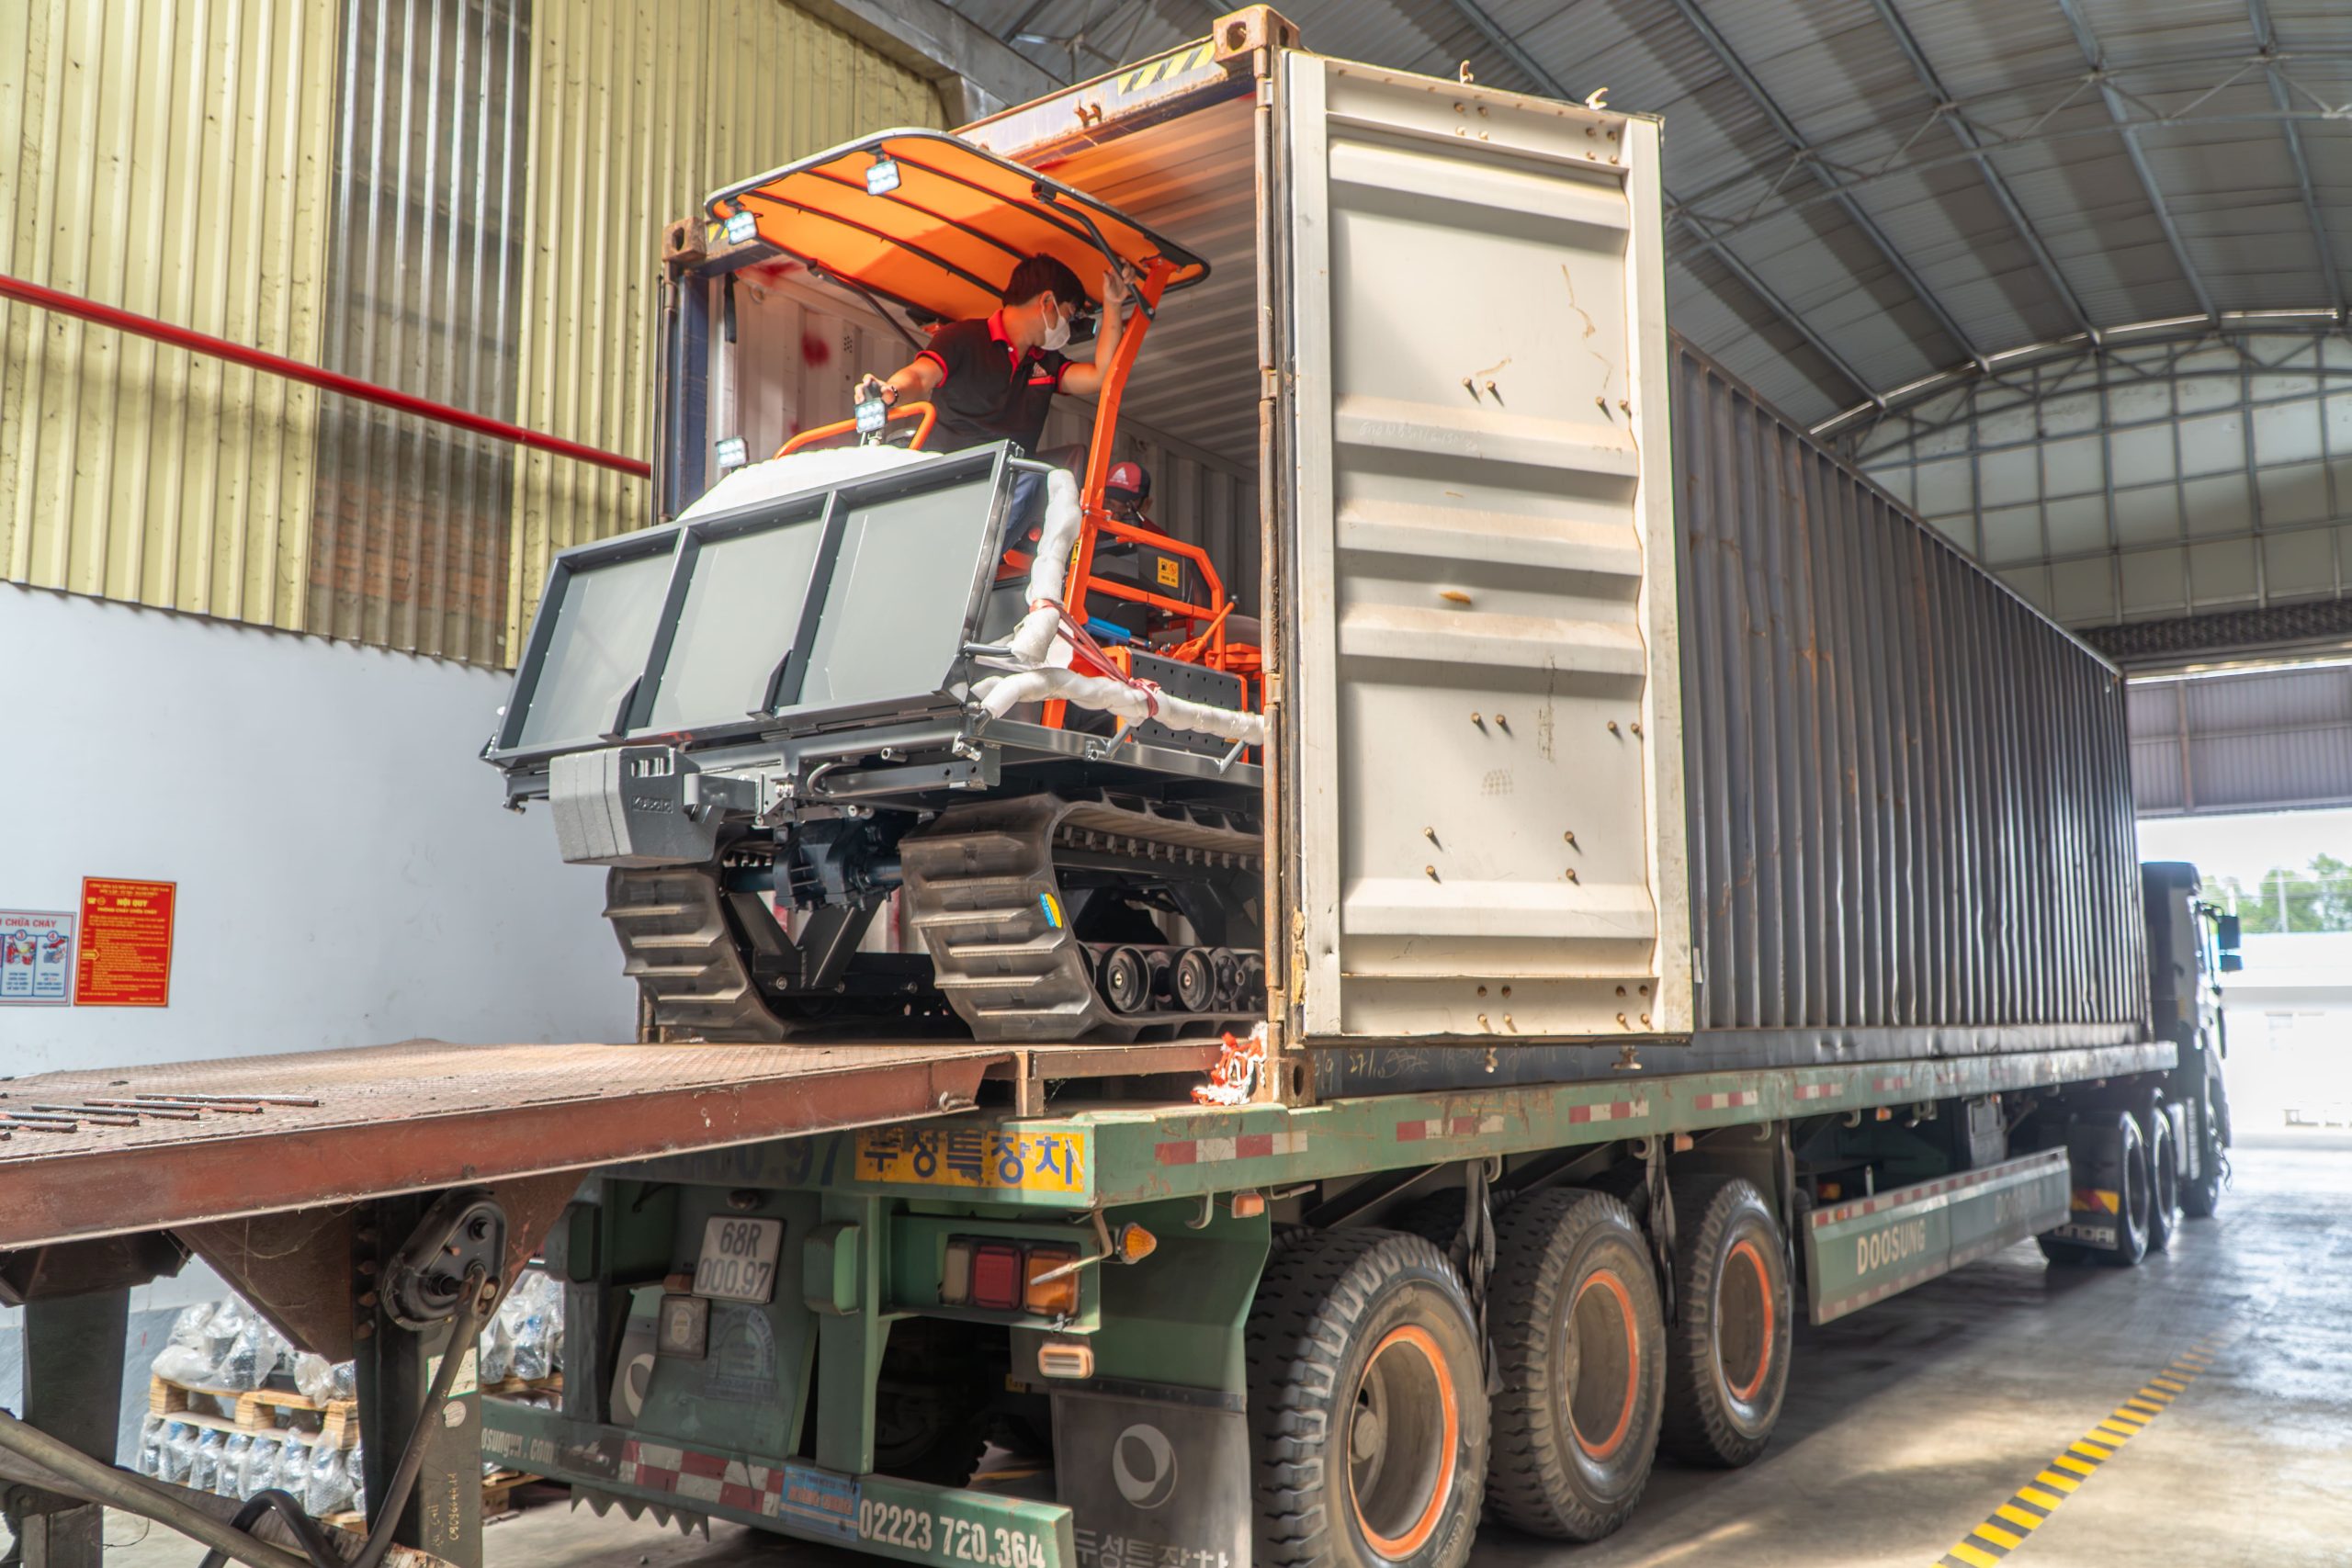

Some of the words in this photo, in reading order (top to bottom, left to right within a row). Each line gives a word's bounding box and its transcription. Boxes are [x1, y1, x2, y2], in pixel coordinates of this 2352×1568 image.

[719, 1222, 762, 1258] 68R
[1857, 1219, 1926, 1276] DOOSUNG
[696, 1258, 772, 1297] 000.97
[858, 1499, 933, 1551] 02223
[939, 1516, 1046, 1568] 720.364
